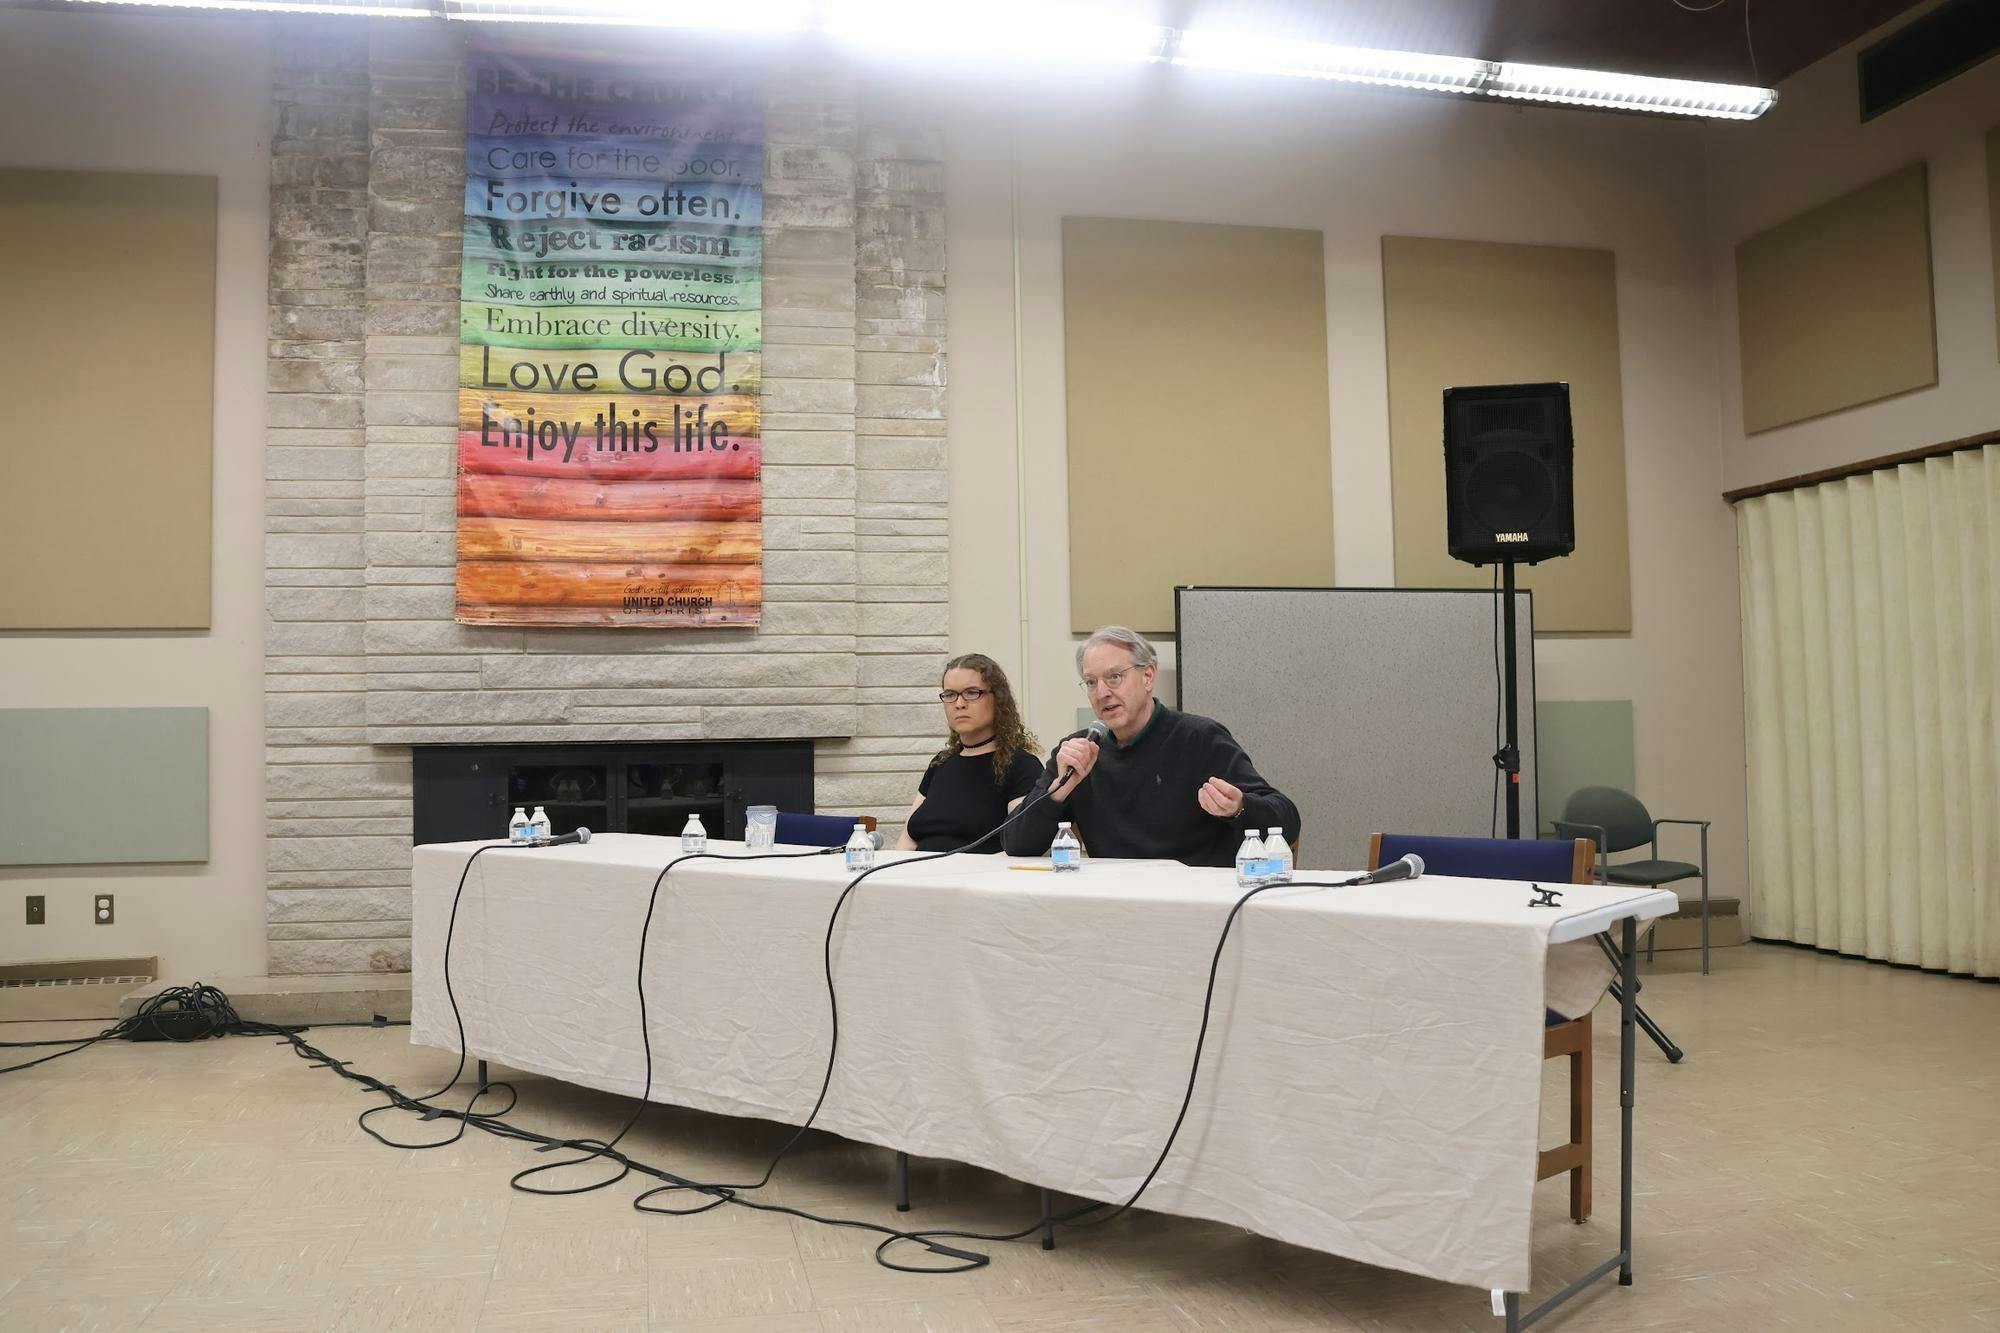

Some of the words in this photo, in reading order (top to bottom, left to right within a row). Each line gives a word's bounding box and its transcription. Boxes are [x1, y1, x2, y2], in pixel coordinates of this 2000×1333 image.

[488, 112, 559, 138] Protect
[568, 113, 599, 134] the
[488, 148, 556, 170] Care
[568, 147, 606, 170] for
[615, 148, 660, 172] the
[487, 180, 621, 218] Forgive
[637, 184, 740, 219] often.
[488, 222, 601, 258] Reject
[612, 228, 740, 257] racism.
[486, 262, 543, 281] Fight
[548, 264, 579, 278] for
[584, 264, 618, 279] the
[624, 266, 739, 284] powerless.
[485, 283, 525, 300] Share
[530, 287, 575, 304] earthly
[581, 287, 606, 300] and
[612, 288, 667, 304] spiritual
[673, 290, 739, 306] resources.
[486, 307, 610, 336] Embrace
[622, 311, 740, 346] diversity.
[483, 345, 598, 392] Love
[619, 350, 740, 394] God.
[481, 402, 581, 463] Enjoy
[594, 402, 657, 452] this
[674, 404, 739, 452] life.
[1495, 532, 1529, 543] YAMAHA
[623, 583, 642, 594] God
[623, 597, 664, 607] UNITED
[667, 597, 713, 607] CHURCH
[623, 607, 642, 615] OF
[653, 607, 712, 615] CHRIST
